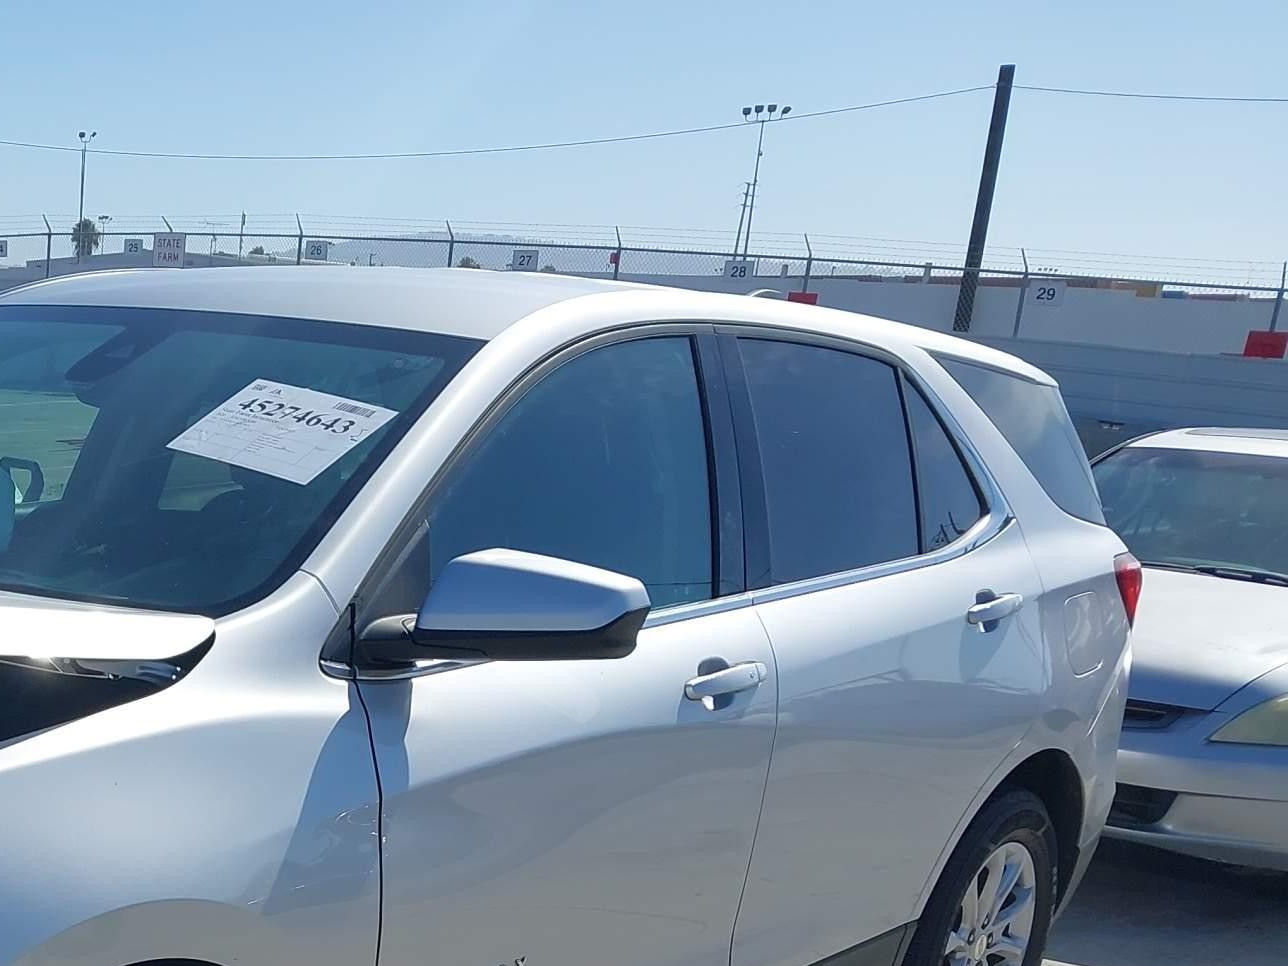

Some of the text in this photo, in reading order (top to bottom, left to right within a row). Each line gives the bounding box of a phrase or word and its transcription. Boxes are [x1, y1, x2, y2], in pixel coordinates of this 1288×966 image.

[128, 243, 139, 253] 25
[157, 238, 182, 248] STATE
[310, 245, 322, 256] 26
[157, 252, 179, 262] FARM
[518, 255, 532, 266] 27
[730, 266, 747, 278] 28
[1036, 288, 1056, 300] 29
[238, 398, 356, 435] 45274643
